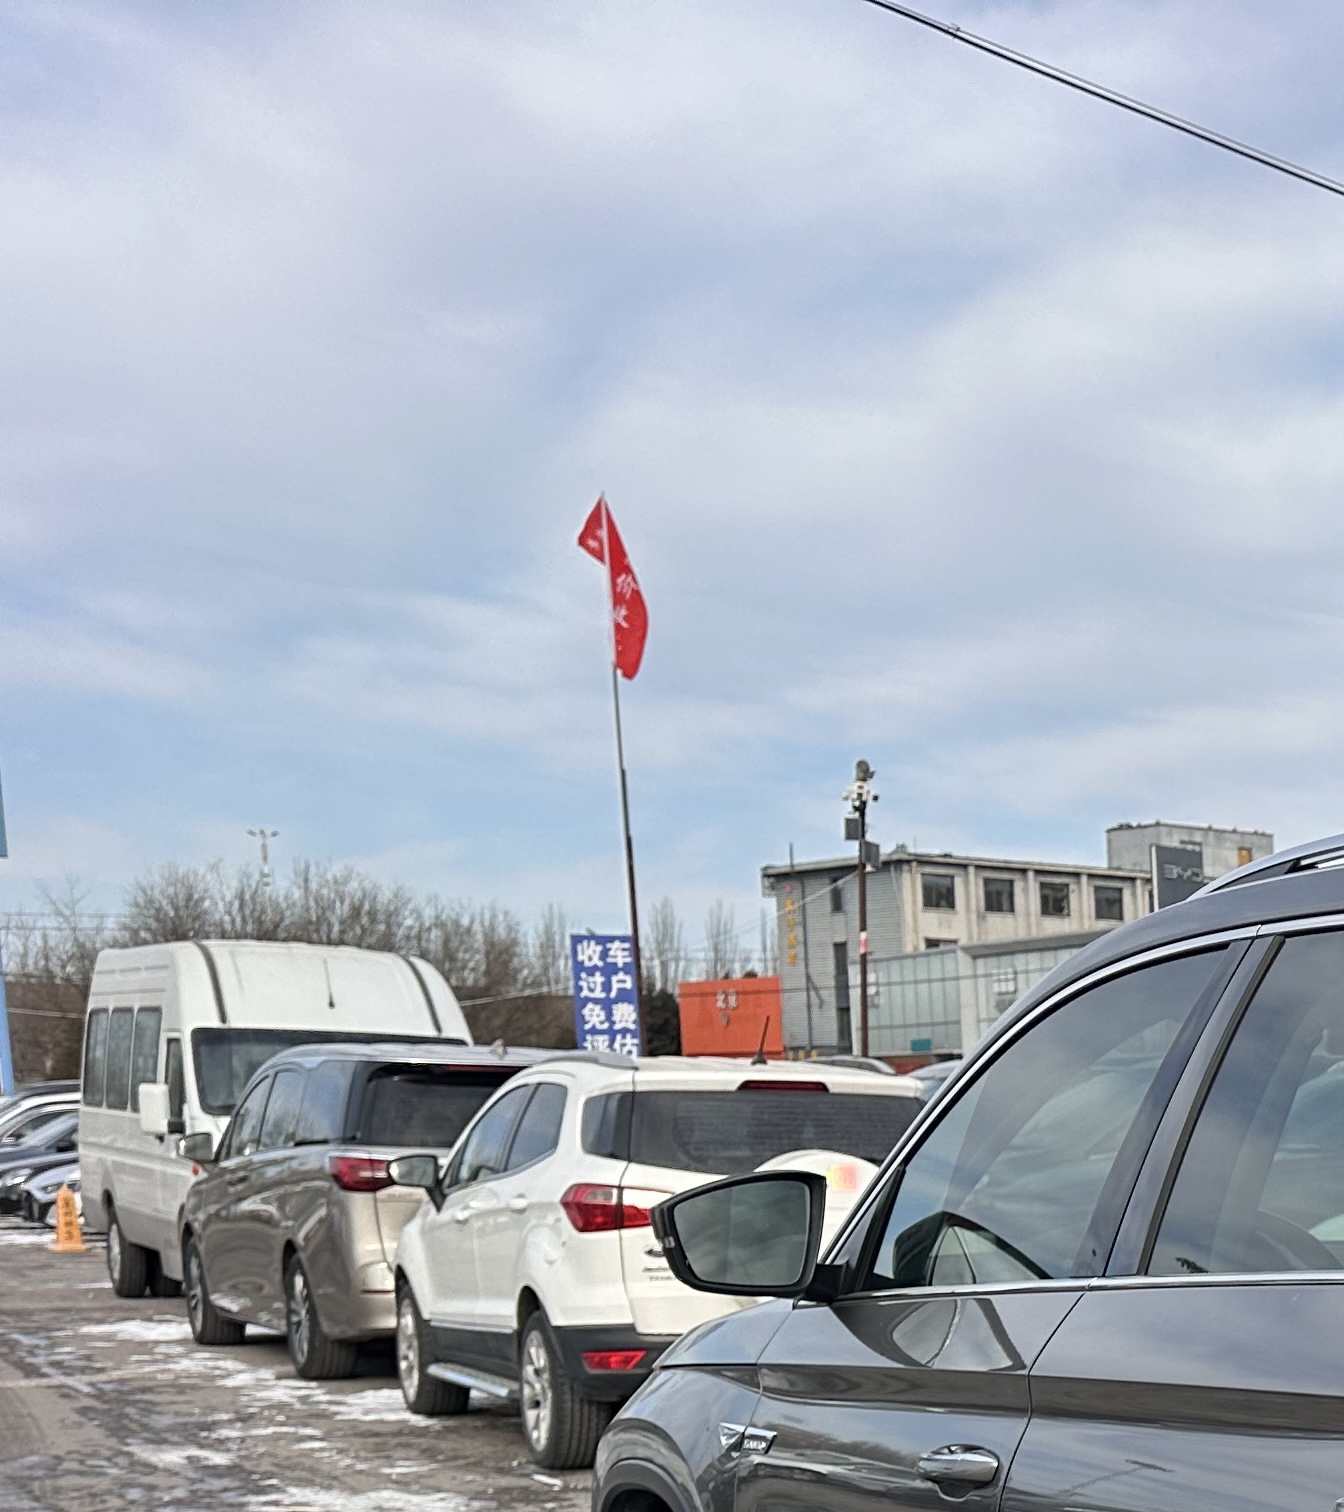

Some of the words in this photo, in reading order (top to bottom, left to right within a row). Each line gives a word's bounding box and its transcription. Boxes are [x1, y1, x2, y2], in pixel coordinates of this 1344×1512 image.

[576, 939, 633, 968] 收车
[578, 970, 633, 999] 过户
[581, 1002, 637, 1031] 免费
